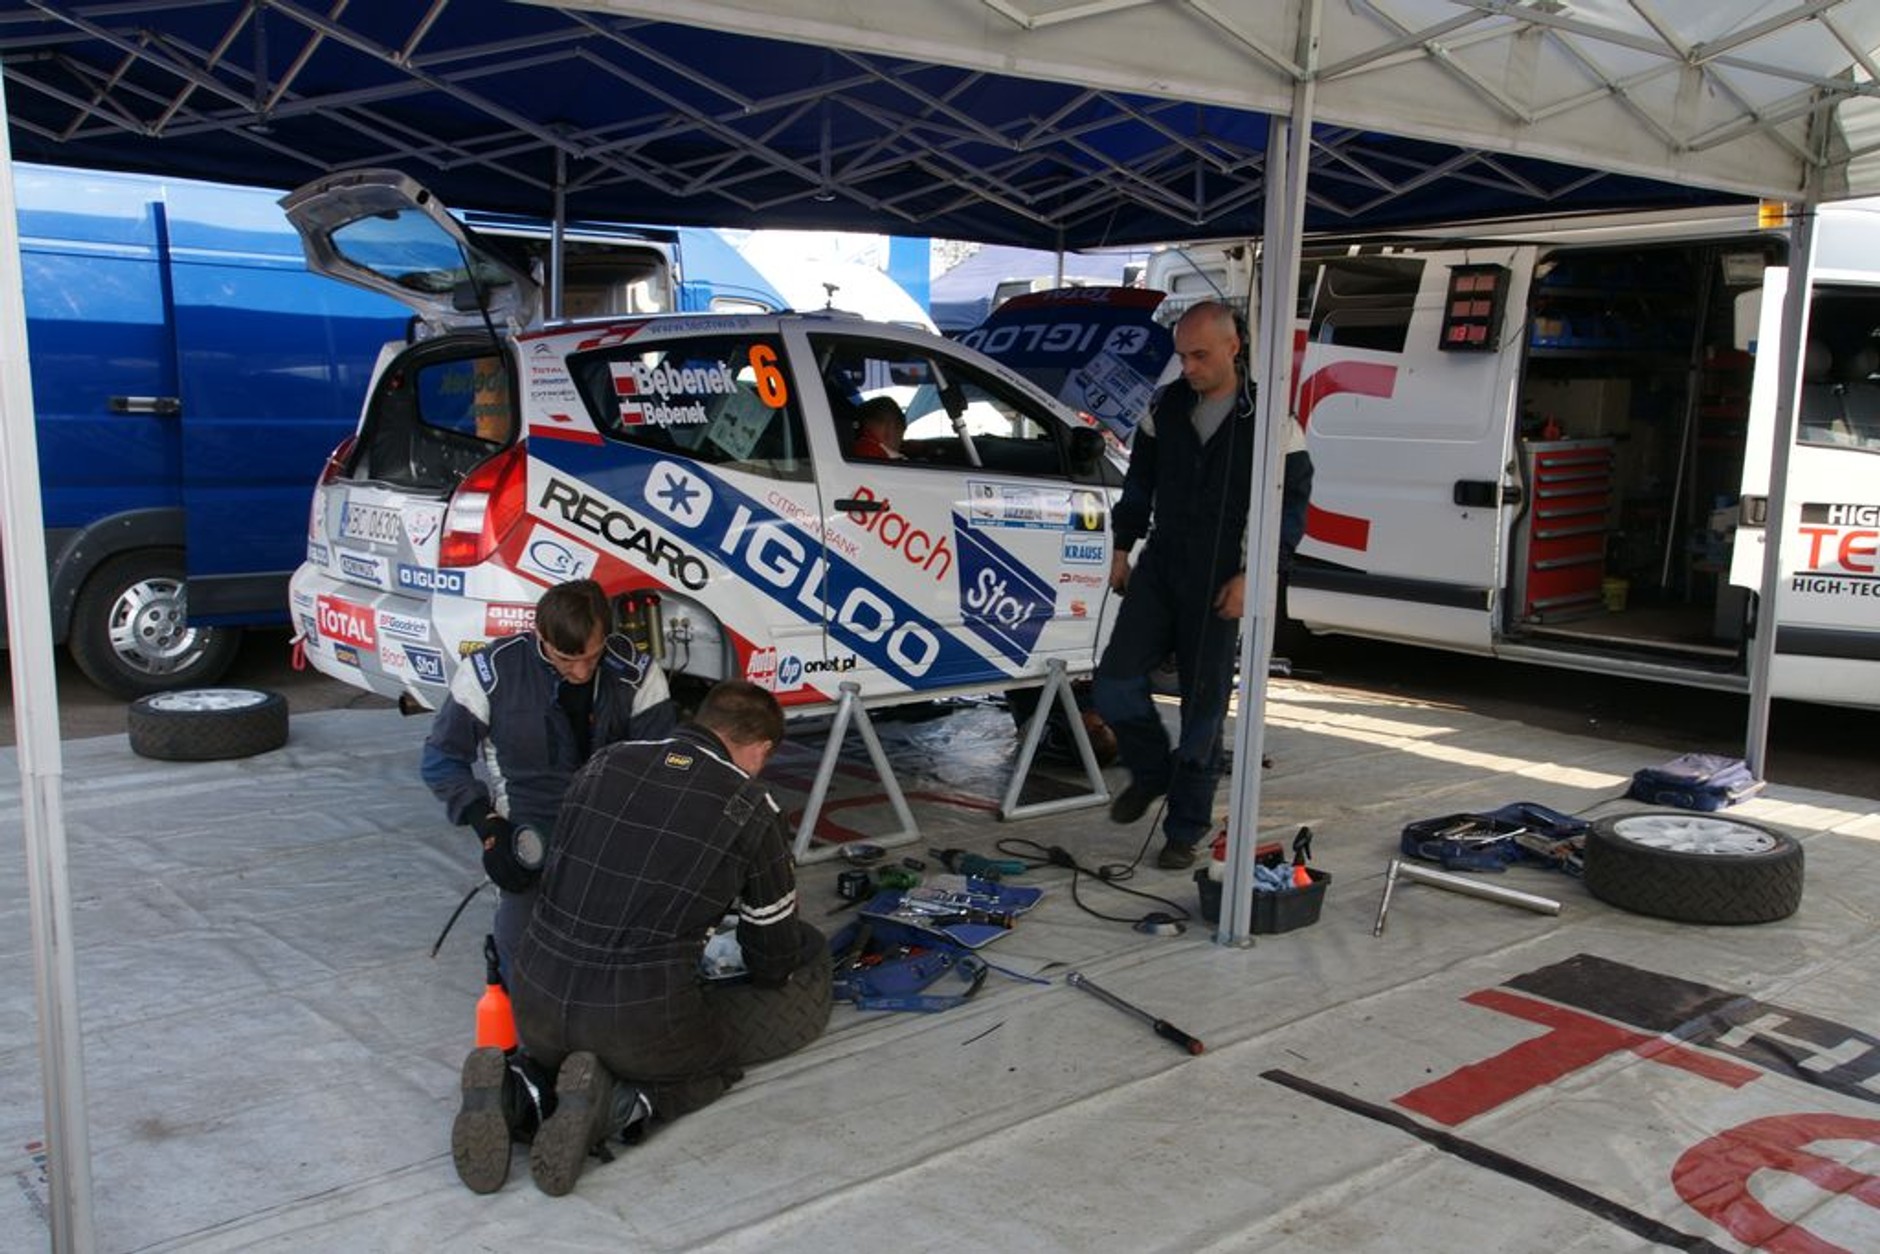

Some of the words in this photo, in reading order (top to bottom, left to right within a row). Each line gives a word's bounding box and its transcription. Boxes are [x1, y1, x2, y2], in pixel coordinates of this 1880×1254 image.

[636, 360, 737, 399] Bębenek
[750, 344, 787, 408] 6
[644, 402, 708, 429] Bębenek
[1828, 504, 1880, 525] HIG
[540, 477, 709, 591] RECARO
[825, 528, 860, 557] BANK
[1064, 544, 1103, 560] KRAUSE
[412, 570, 462, 591] IGLOO
[721, 505, 940, 677] IGLOO
[318, 600, 374, 644] TOTAL
[414, 655, 439, 676] Stal
[804, 653, 857, 674] onet.pl
